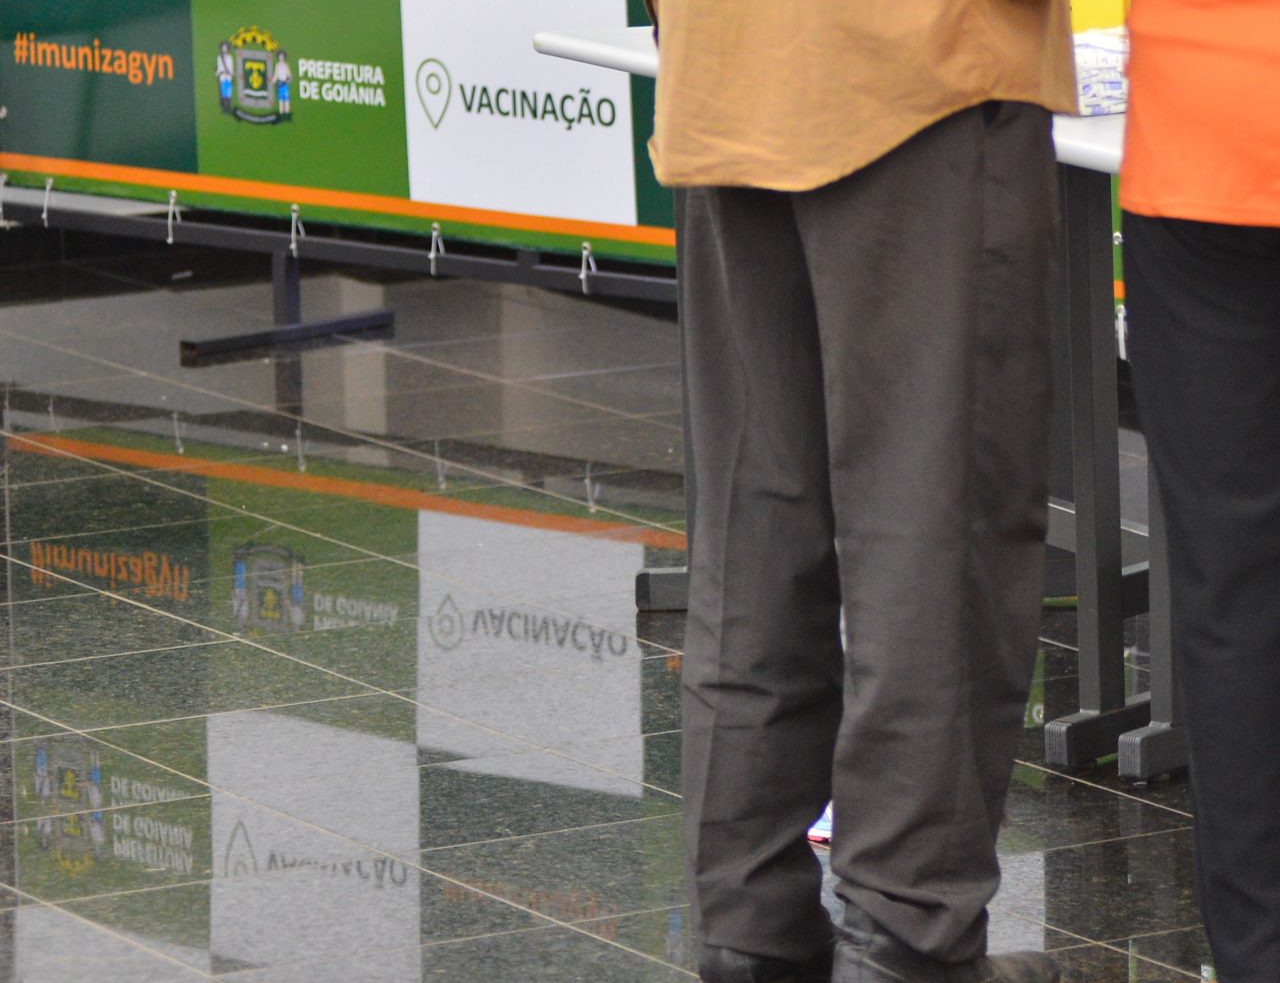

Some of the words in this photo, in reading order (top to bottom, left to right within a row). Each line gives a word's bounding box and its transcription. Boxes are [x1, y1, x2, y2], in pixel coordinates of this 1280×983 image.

[15, 33, 174, 84] #imunizagyn
[299, 59, 385, 85] PREFEITURA
[300, 81, 320, 100] DE
[321, 82, 386, 107] GOIÂNIA
[460, 85, 616, 131] VACINAÇÃO
